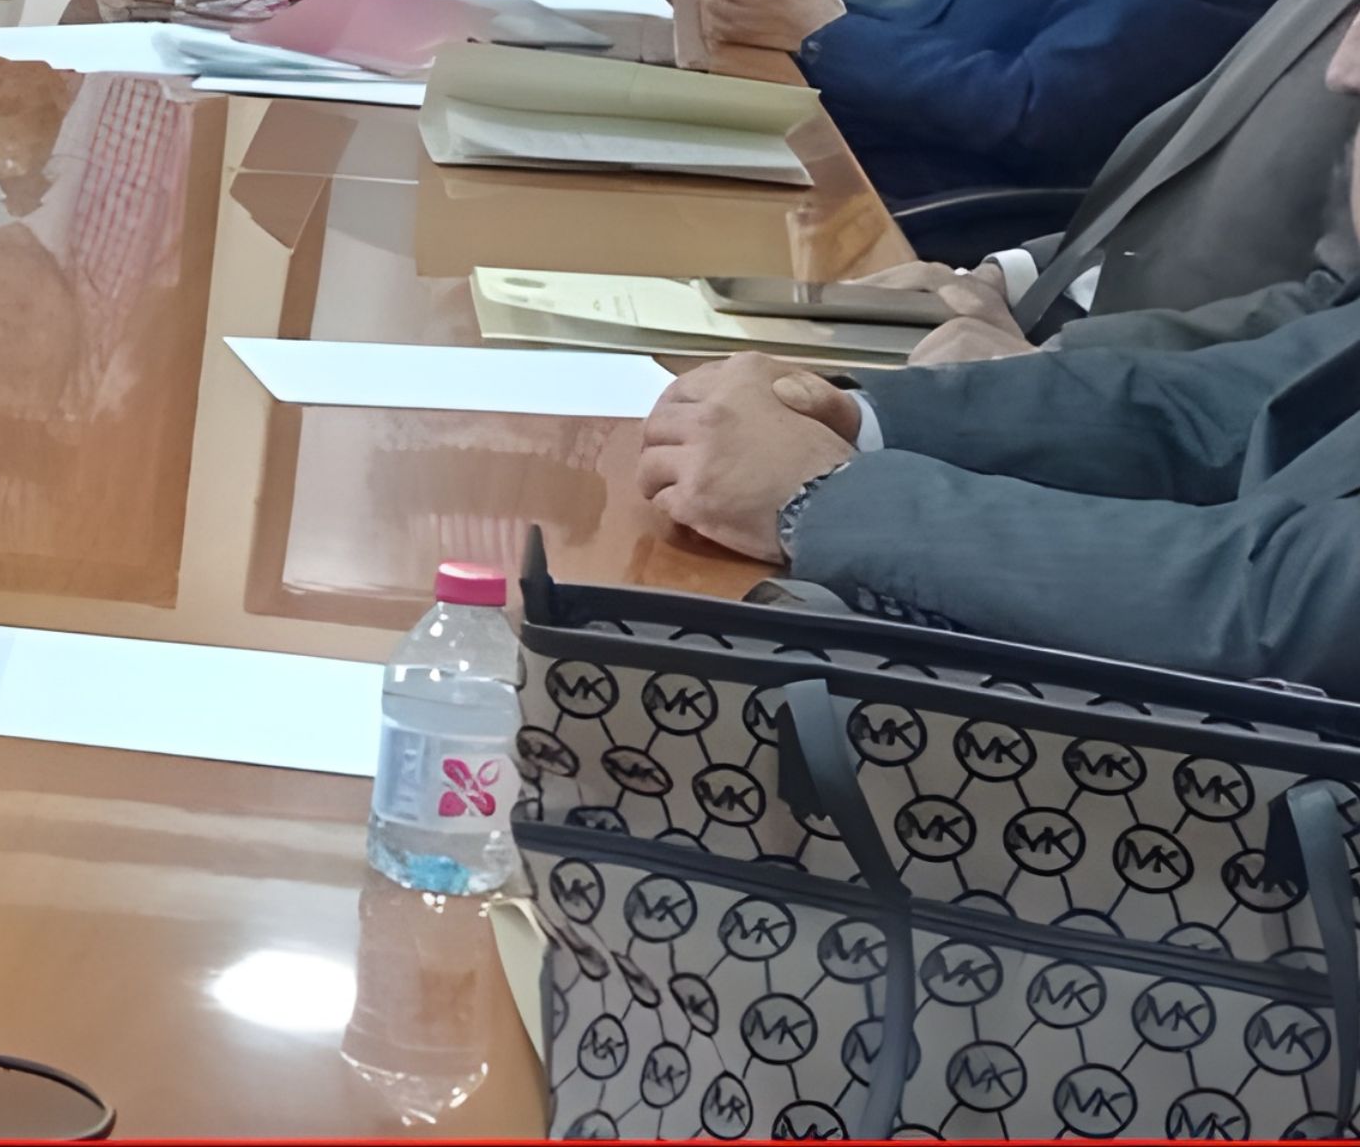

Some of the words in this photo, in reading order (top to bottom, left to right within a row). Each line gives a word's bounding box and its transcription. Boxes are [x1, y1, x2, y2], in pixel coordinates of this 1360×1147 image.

[552, 672, 610, 704] MK
[647, 682, 707, 720] MK
[850, 713, 918, 752] MK
[959, 730, 1025, 765] MK
[1067, 748, 1137, 781] MK
[695, 779, 758, 818] MK
[1180, 767, 1243, 809] MK
[898, 810, 966, 846] MK
[1007, 823, 1075, 861] MK
[1119, 838, 1183, 878] MK
[632, 886, 688, 928] MK
[726, 909, 790, 949] MK
[924, 951, 996, 994] MK
[1033, 973, 1099, 1015] MK
[746, 1007, 809, 1051] MK
[1139, 993, 1205, 1037] MK
[1252, 1015, 1323, 1059] MK
[951, 1054, 1021, 1099] MK
[1061, 1079, 1129, 1126] MK
